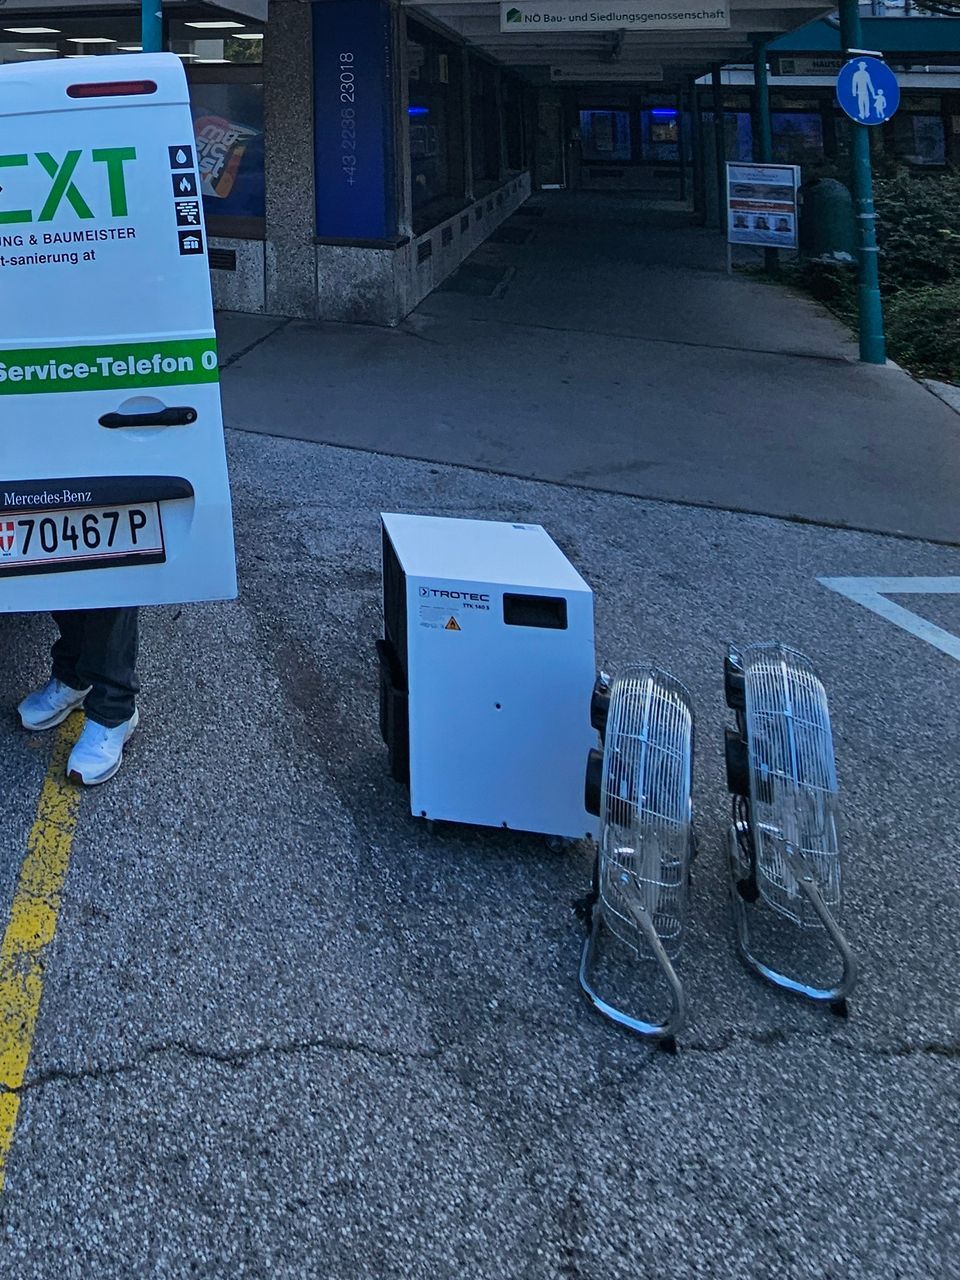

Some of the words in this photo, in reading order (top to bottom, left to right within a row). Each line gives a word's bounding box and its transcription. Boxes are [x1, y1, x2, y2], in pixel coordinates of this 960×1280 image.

[543, 14, 566, 23] Bau-
[569, 13, 588, 22] und
[590, 10, 724, 23] Siedlungsgenossenschaft
[340, 52, 355, 103] 23018
[341, 107, 356, 150] 2236
[342, 154, 357, 186] +43
[29, 235, 38, 245] &
[43, 227, 136, 244] BAUMEISTER
[201, 350, 218, 370] 0
[4, 490, 92, 506] Mercedes-Benz
[430, 589, 490, 602] TROTEC
